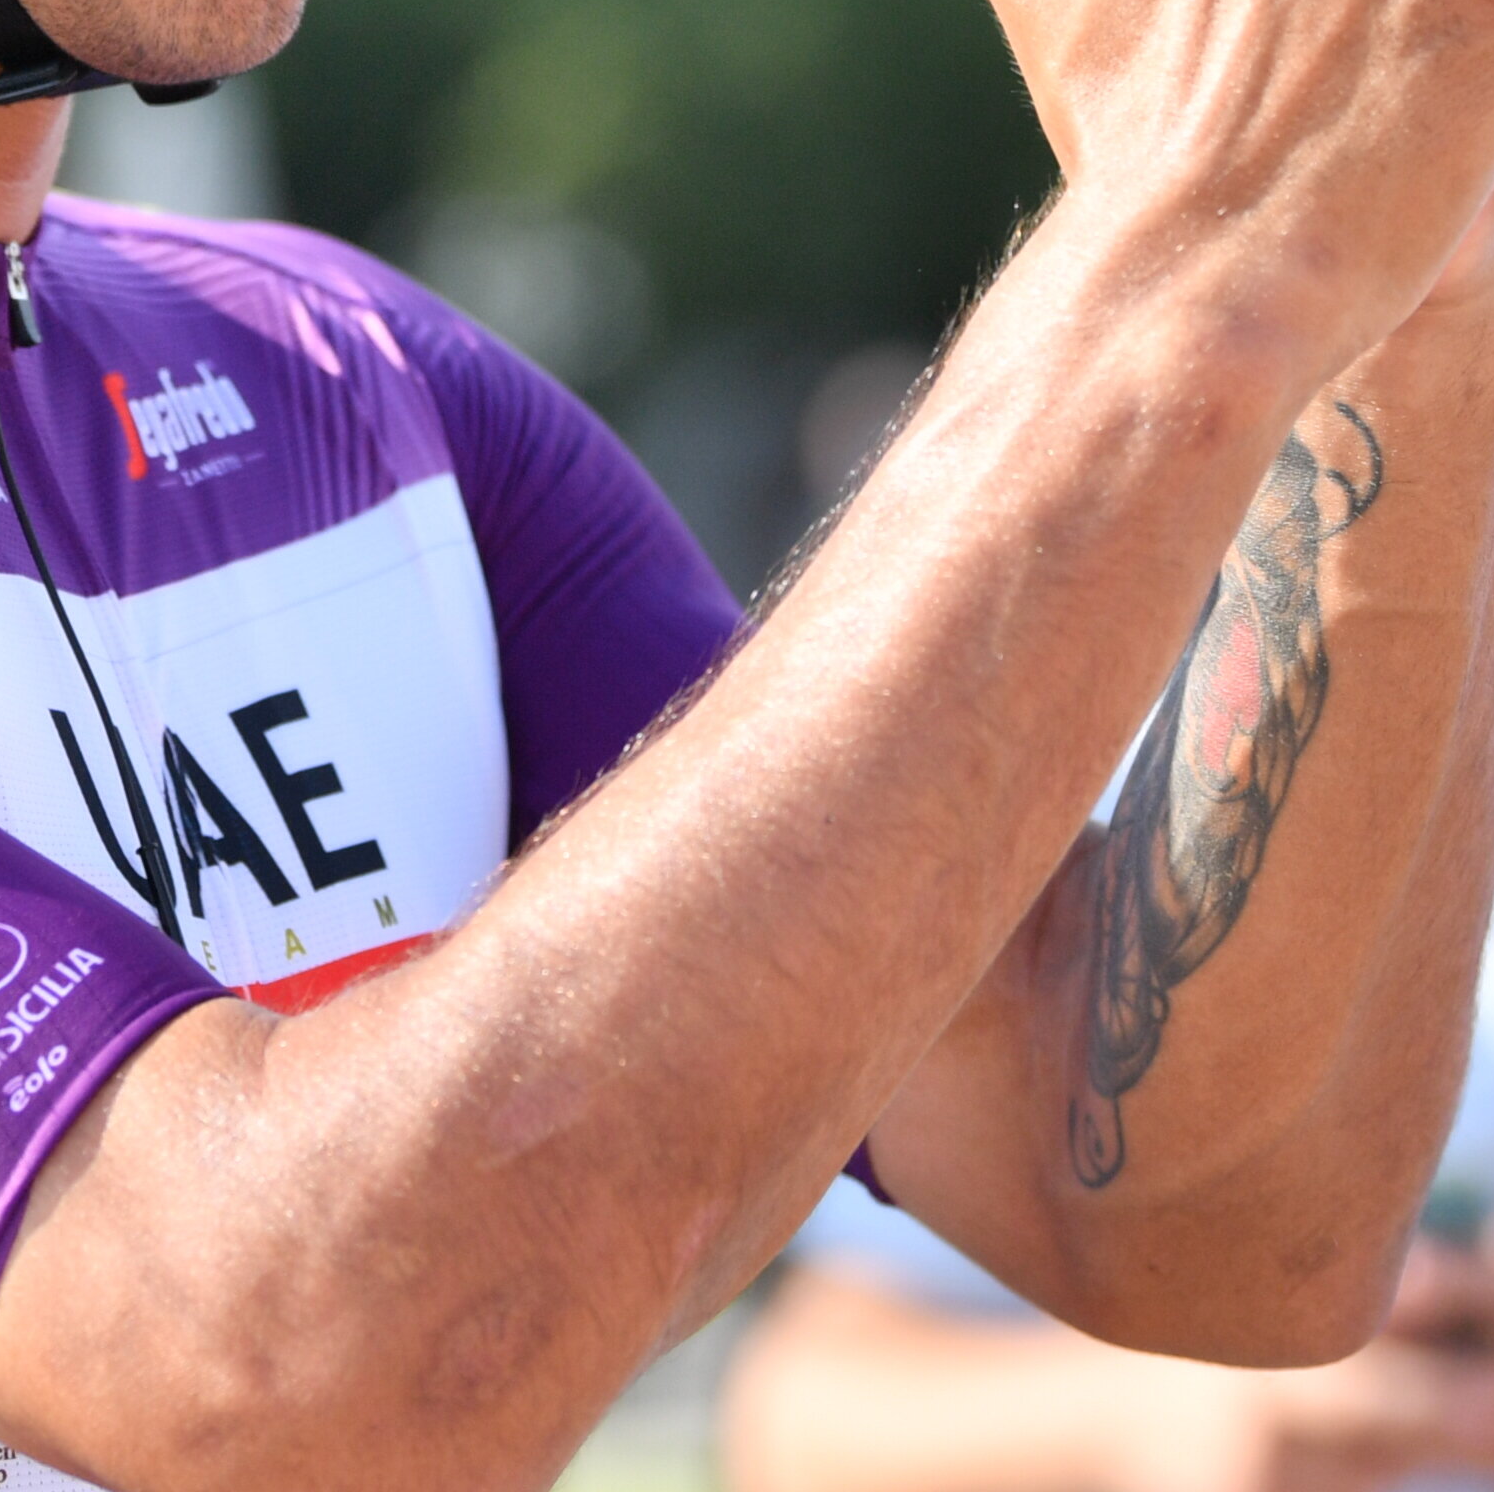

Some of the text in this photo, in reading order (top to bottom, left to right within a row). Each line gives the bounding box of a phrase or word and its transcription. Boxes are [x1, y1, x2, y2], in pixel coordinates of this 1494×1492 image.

[102, 361, 257, 481] Segafredo
[49, 689, 387, 920] UAE
[201, 894, 399, 972] EAM
